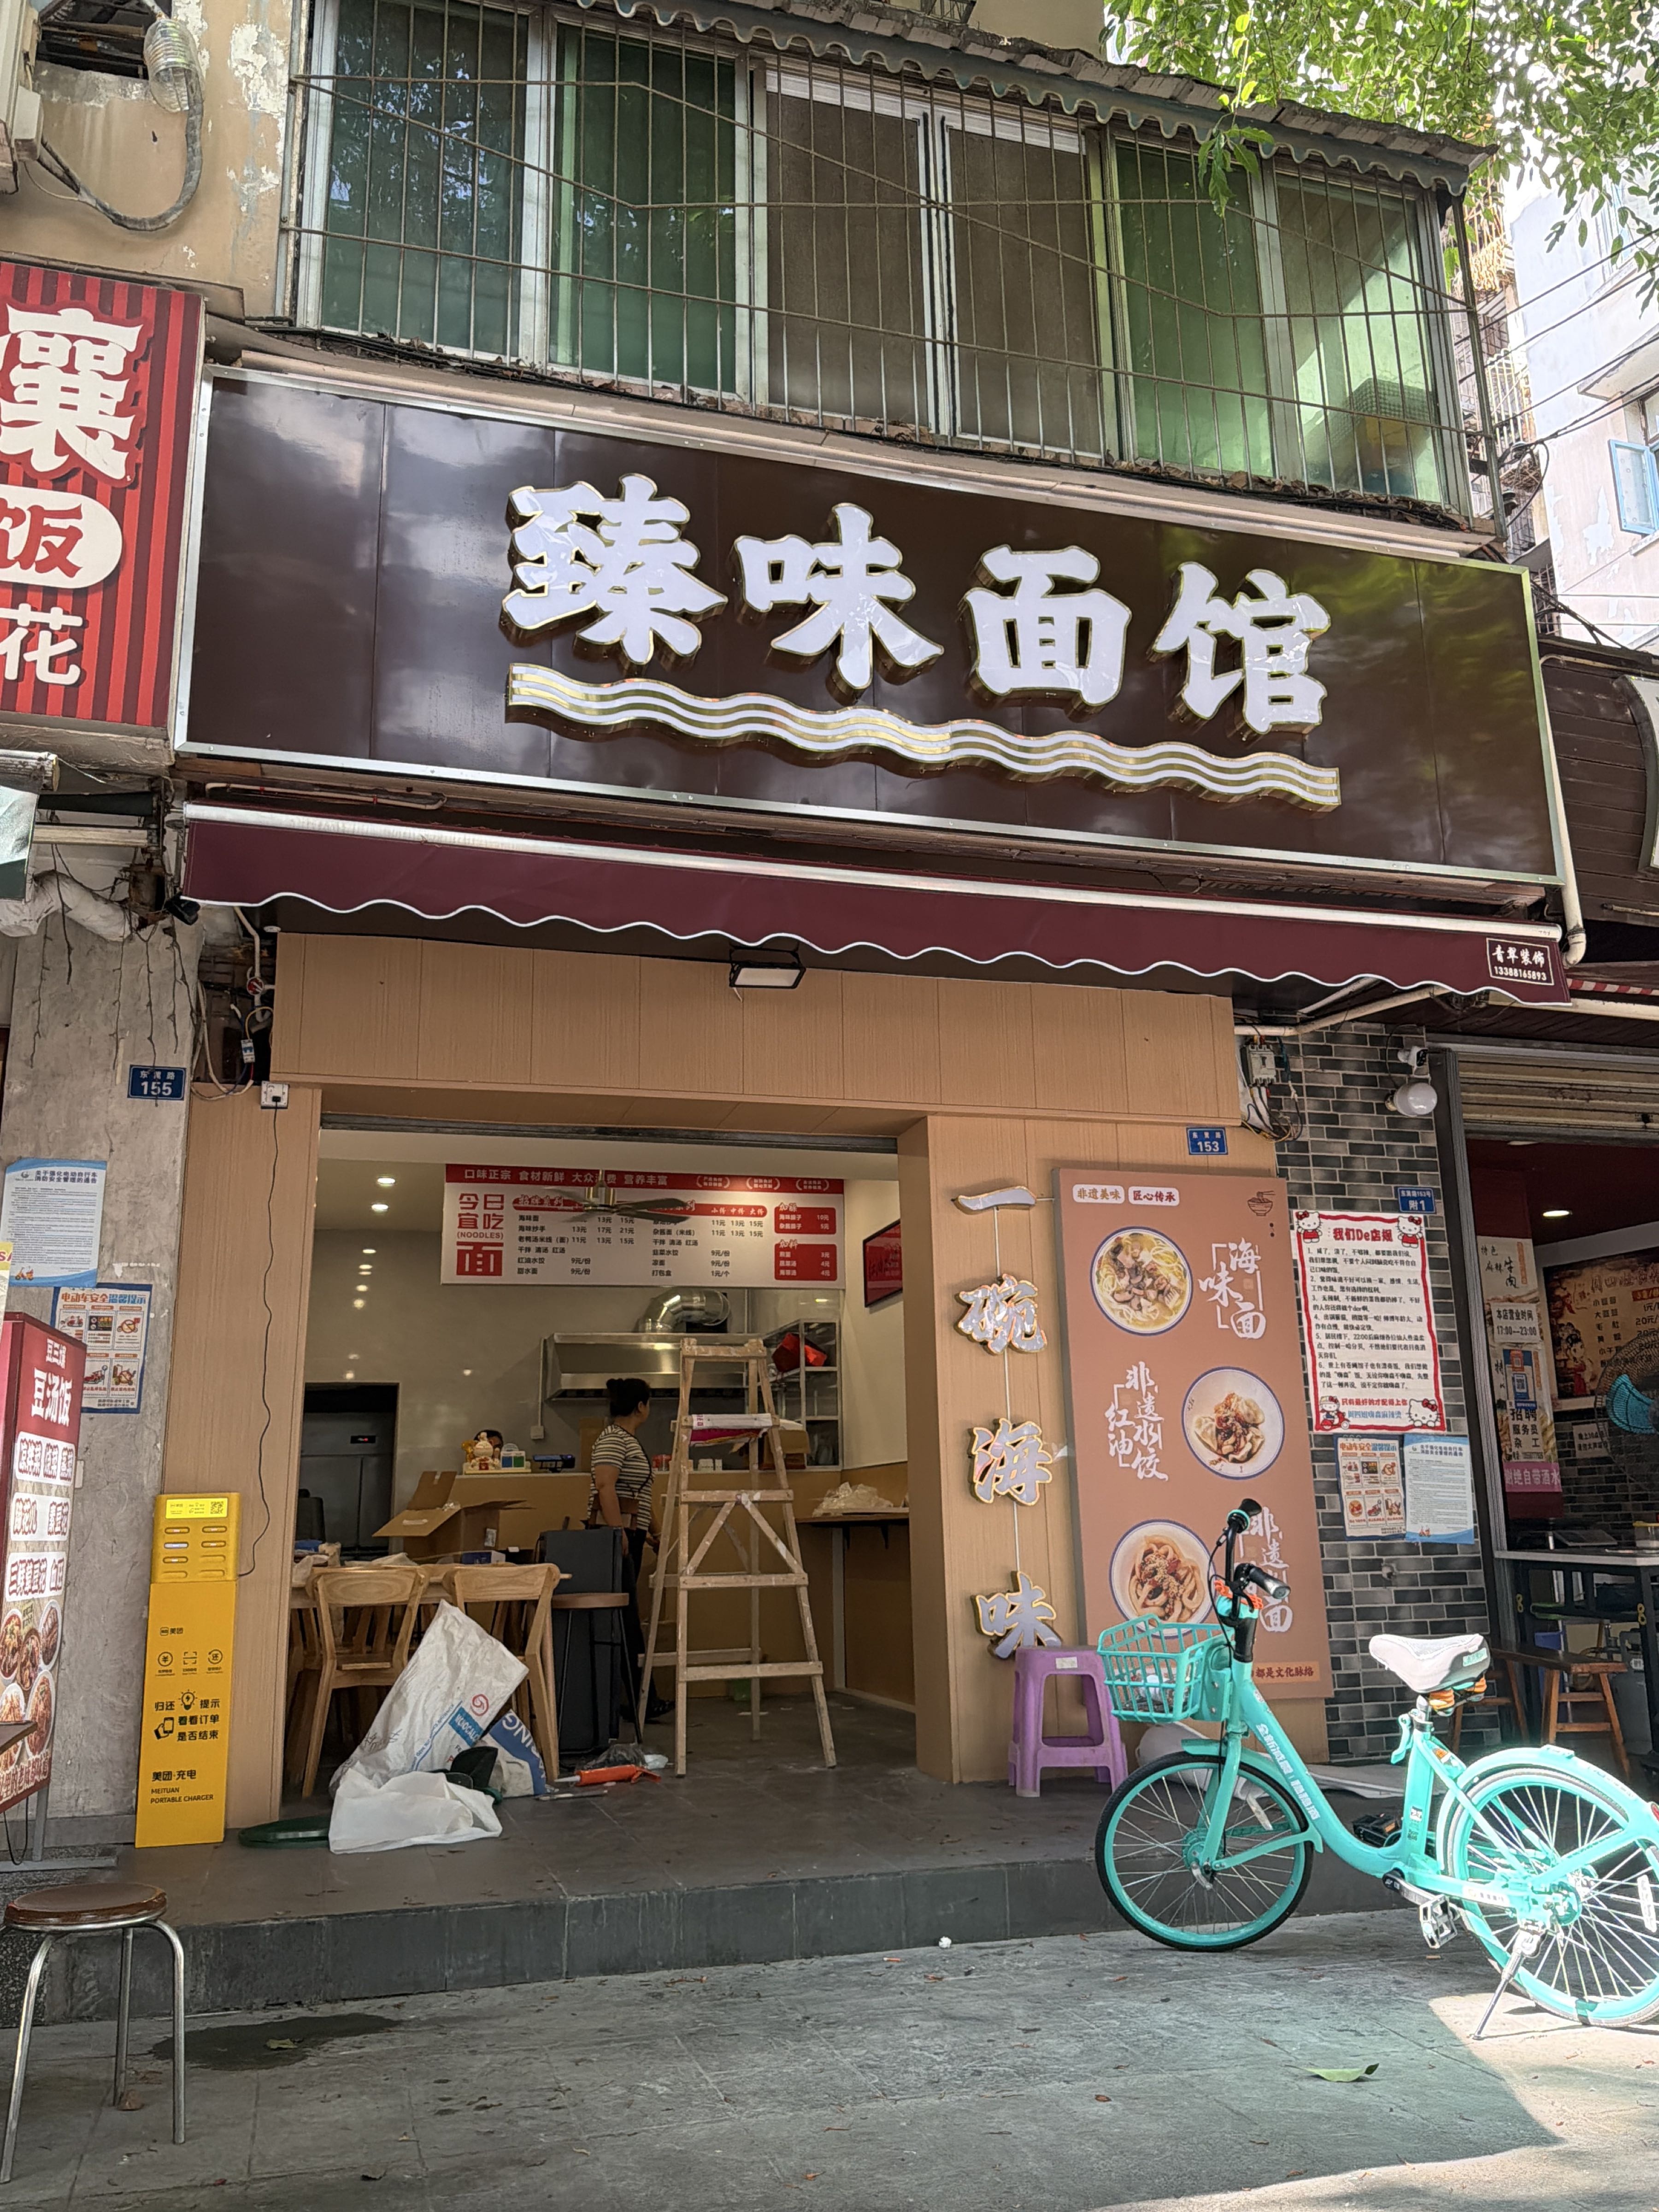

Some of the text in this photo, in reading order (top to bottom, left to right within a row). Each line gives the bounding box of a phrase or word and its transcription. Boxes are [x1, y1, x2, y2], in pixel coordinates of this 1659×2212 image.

[501, 473, 1332, 735] 臻味面馆
[0, 603, 83, 686] 花
[141, 1081, 172, 1095] 155
[1197, 1141, 1219, 1152] 153
[465, 1169, 511, 1180] 口味正宗
[519, 1171, 564, 1182] 食材新鲜
[624, 1174, 668, 1186] 营养丰富
[1077, 1187, 1176, 1202] 非遗美味 匠心传承
[459, 1194, 504, 1210] 今日
[1409, 1200, 1425, 1211] 附1
[1333, 1228, 1394, 1242] 我们De店规
[457, 1241, 504, 1276] 面
[1496, 1309, 1534, 1321] 本店营业时间
[31, 1367, 72, 1427] 豆汤饭
[956, 1186, 1062, 1658] 一碗海味
[1511, 1409, 1537, 1422] 招聘
[1513, 1424, 1538, 1435] 服务员
[1504, 1469, 1560, 1487] 谢绝自带酒水
[154, 1699, 220, 1711] 归还 提示
[178, 1714, 220, 1725] 看看订单
[177, 1730, 219, 1741] 是否结束
[150, 1795, 182, 1804] PORTABLE
